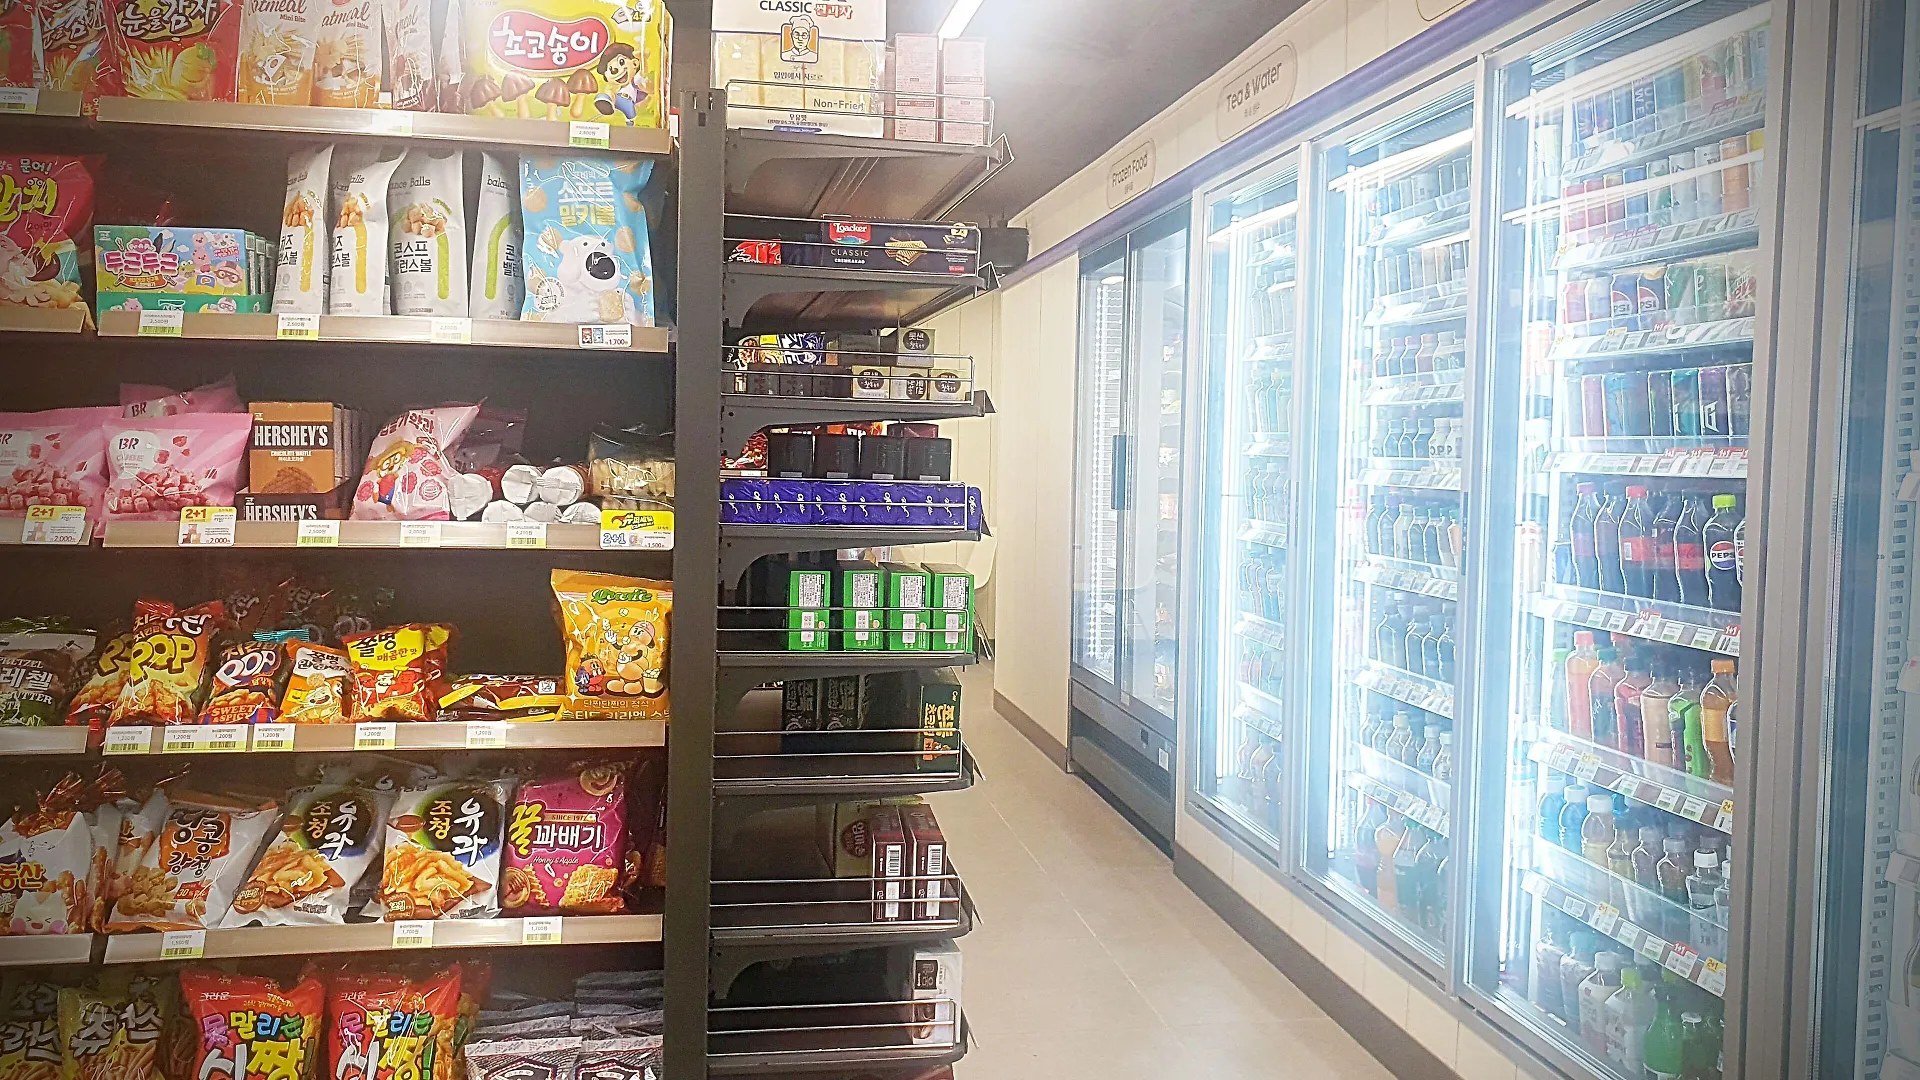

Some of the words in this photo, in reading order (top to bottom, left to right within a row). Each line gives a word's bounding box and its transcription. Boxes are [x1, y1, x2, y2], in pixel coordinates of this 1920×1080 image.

[759, 1, 812, 13] CLASSIC
[120, 0, 220, 36] 눈을감자
[493, 15, 599, 66] 초코송이
[1226, 90, 1243, 113] Tea
[1243, 82, 1252, 100] &
[1252, 62, 1282, 96] Water
[19, 158, 52, 175] 문어!
[1131, 153, 1148, 174] Food
[409, 175, 431, 188] Balls
[833, 221, 868, 234] Loacker
[393, 240, 429, 259] 콘스프
[830, 248, 869, 257] CLASSIC
[104, 251, 179, 278] 두근두근
[394, 258, 433, 275] 밸런스볼
[130, 401, 148, 417] BR
[118, 437, 140, 450] BR
[254, 425, 329, 447] HERSHEY'S
[31, 506, 54, 517] 2+1
[186, 508, 207, 519] 2+1
[245, 504, 318, 521] HERSHEY'S
[602, 532, 626, 544] 2+1
[1725, 625, 1738, 636] 1+1
[351, 632, 397, 658] 쫄병
[129, 634, 197, 685] POP
[376, 647, 409, 662] 매콤한
[409, 648, 418, 656] 맛
[215, 649, 278, 688] POP
[211, 704, 256, 718] SWEET
[583, 699, 629, 709] 단짠단짠의
[307, 800, 332, 840] 조청
[429, 799, 453, 840] 조청
[318, 799, 358, 862] 유과
[450, 797, 489, 868] 유과
[167, 850, 213, 878] 강정
[533, 855, 554, 865] Honey
[560, 856, 580, 865] Apple
[1675, 943, 1686, 955] 1+1
[201, 1010, 304, 1051] 못말리는
[340, 1008, 435, 1048] 못말리는
